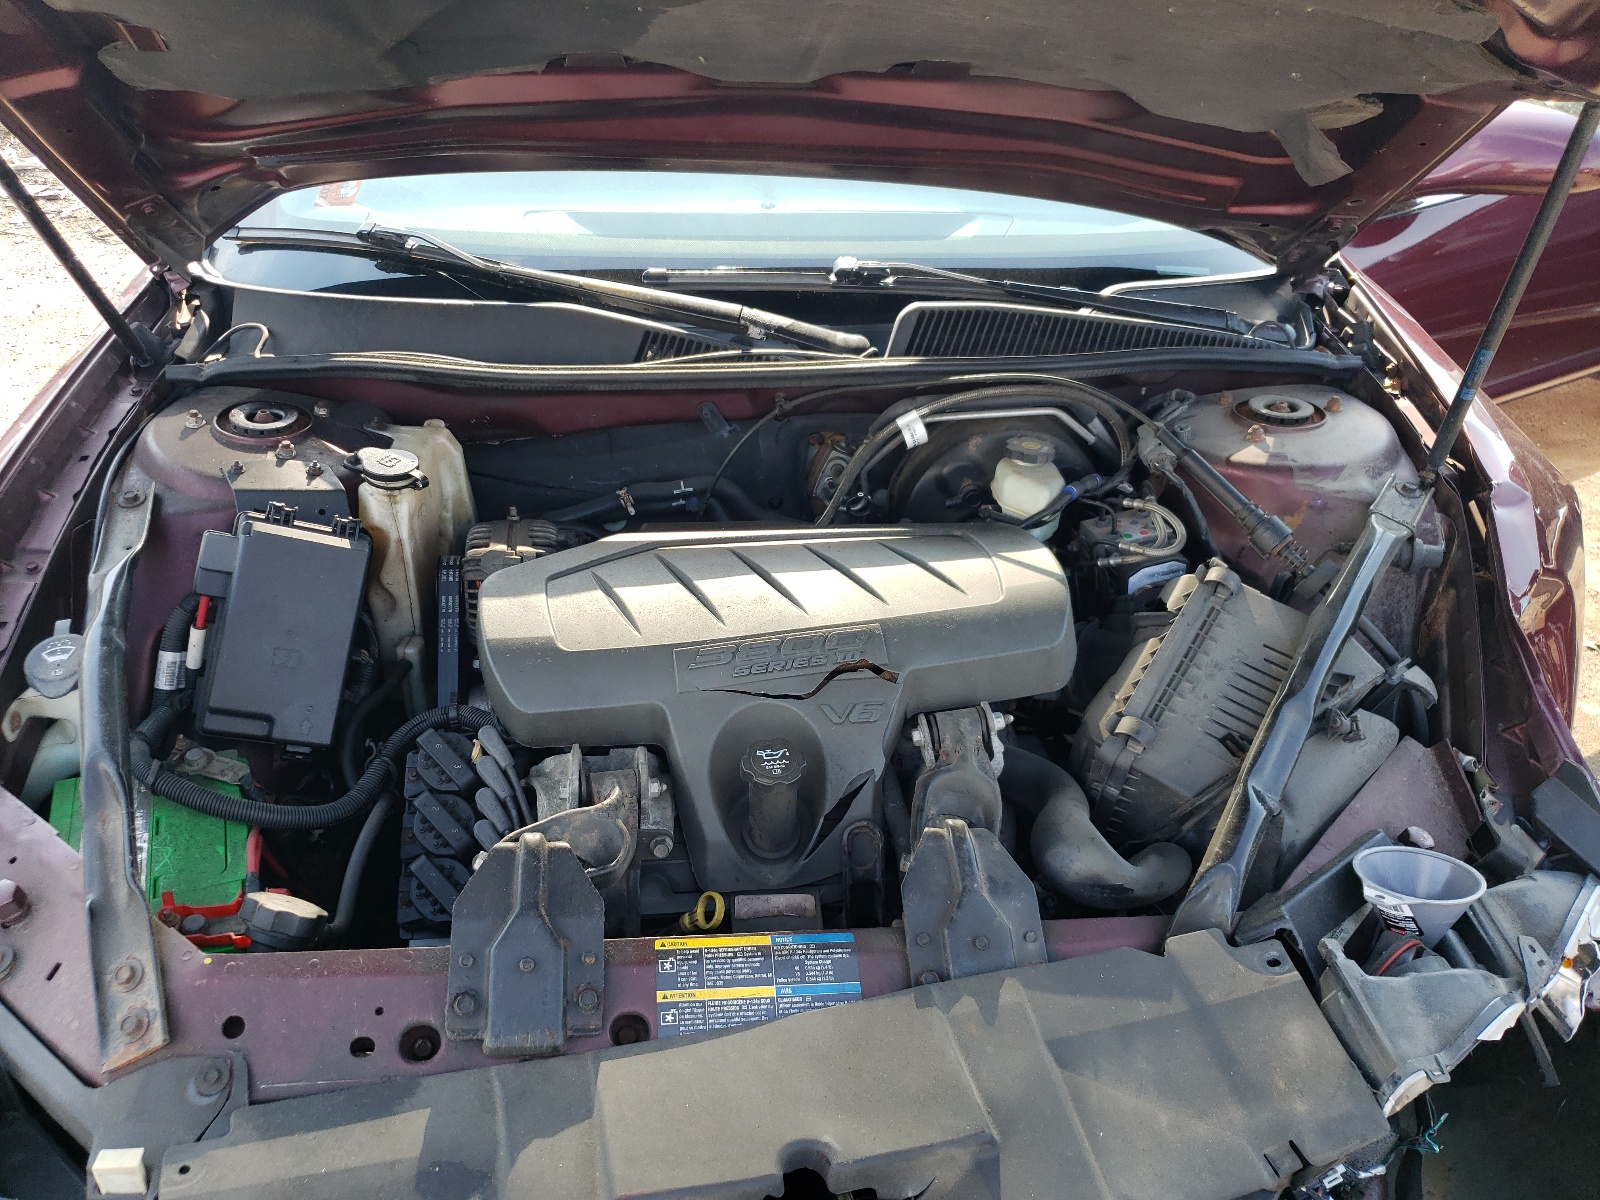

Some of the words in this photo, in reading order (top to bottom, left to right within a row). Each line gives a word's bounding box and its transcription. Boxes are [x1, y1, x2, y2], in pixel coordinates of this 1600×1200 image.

[688, 628, 871, 671] 3800
[732, 654, 829, 678] SERIES
[819, 700, 885, 725] V6
